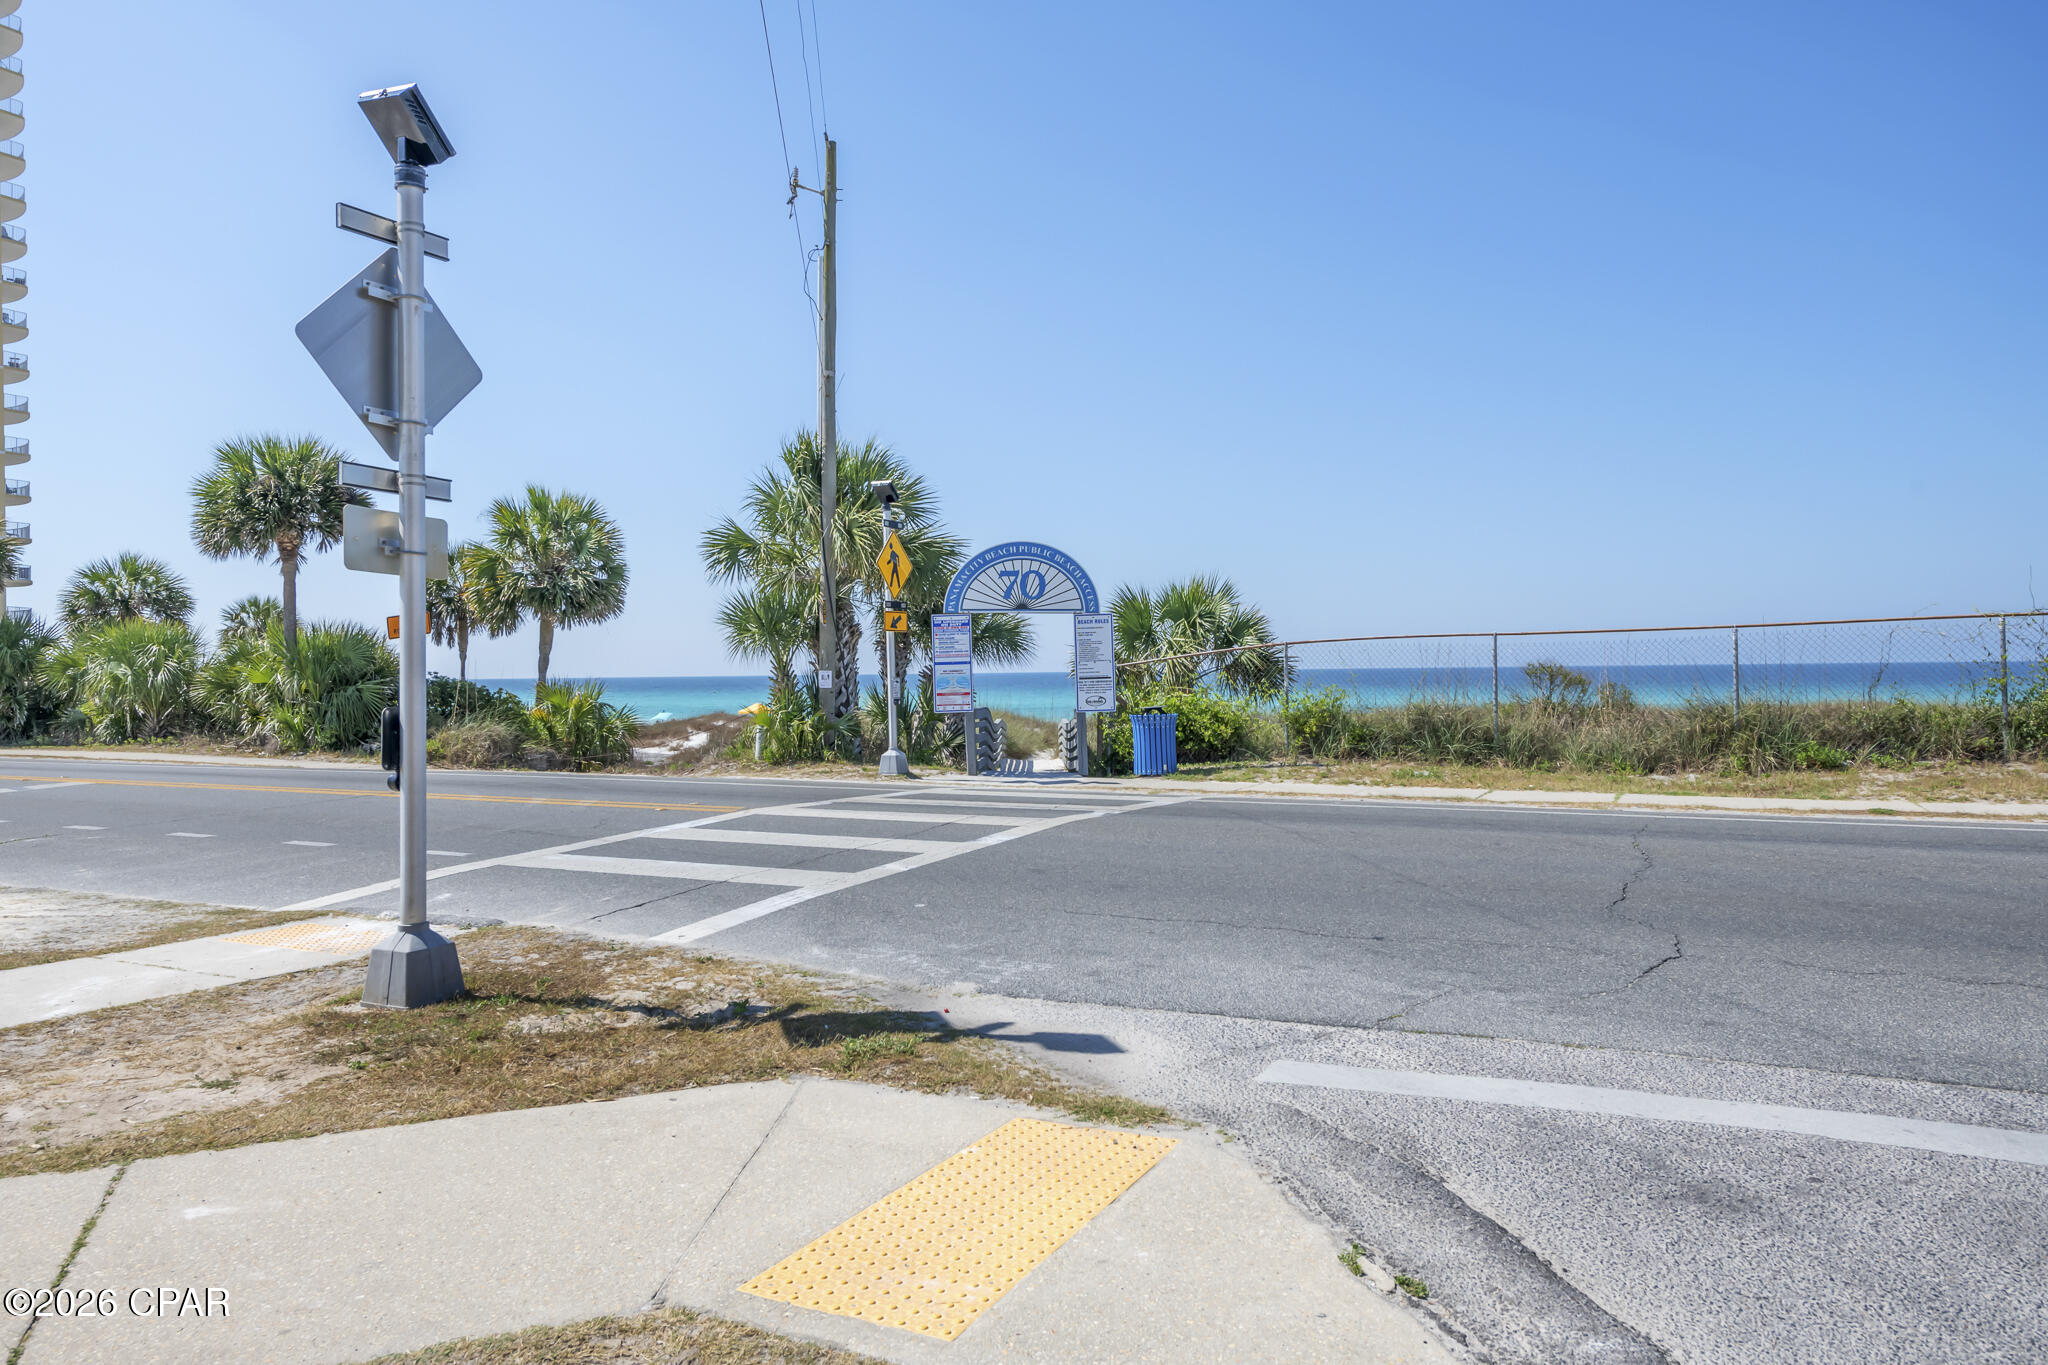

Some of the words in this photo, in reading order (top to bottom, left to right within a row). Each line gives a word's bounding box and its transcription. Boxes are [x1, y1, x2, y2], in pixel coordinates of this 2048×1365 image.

[947, 574, 968, 612] PANAMA
[965, 557, 984, 576] CITY
[985, 545, 1017, 561] BEACH
[1019, 545, 1055, 559] PUBLIC
[1054, 553, 1082, 578] BEACH
[1080, 578, 1096, 612] ACCESS
[998, 569, 1046, 601] 70
